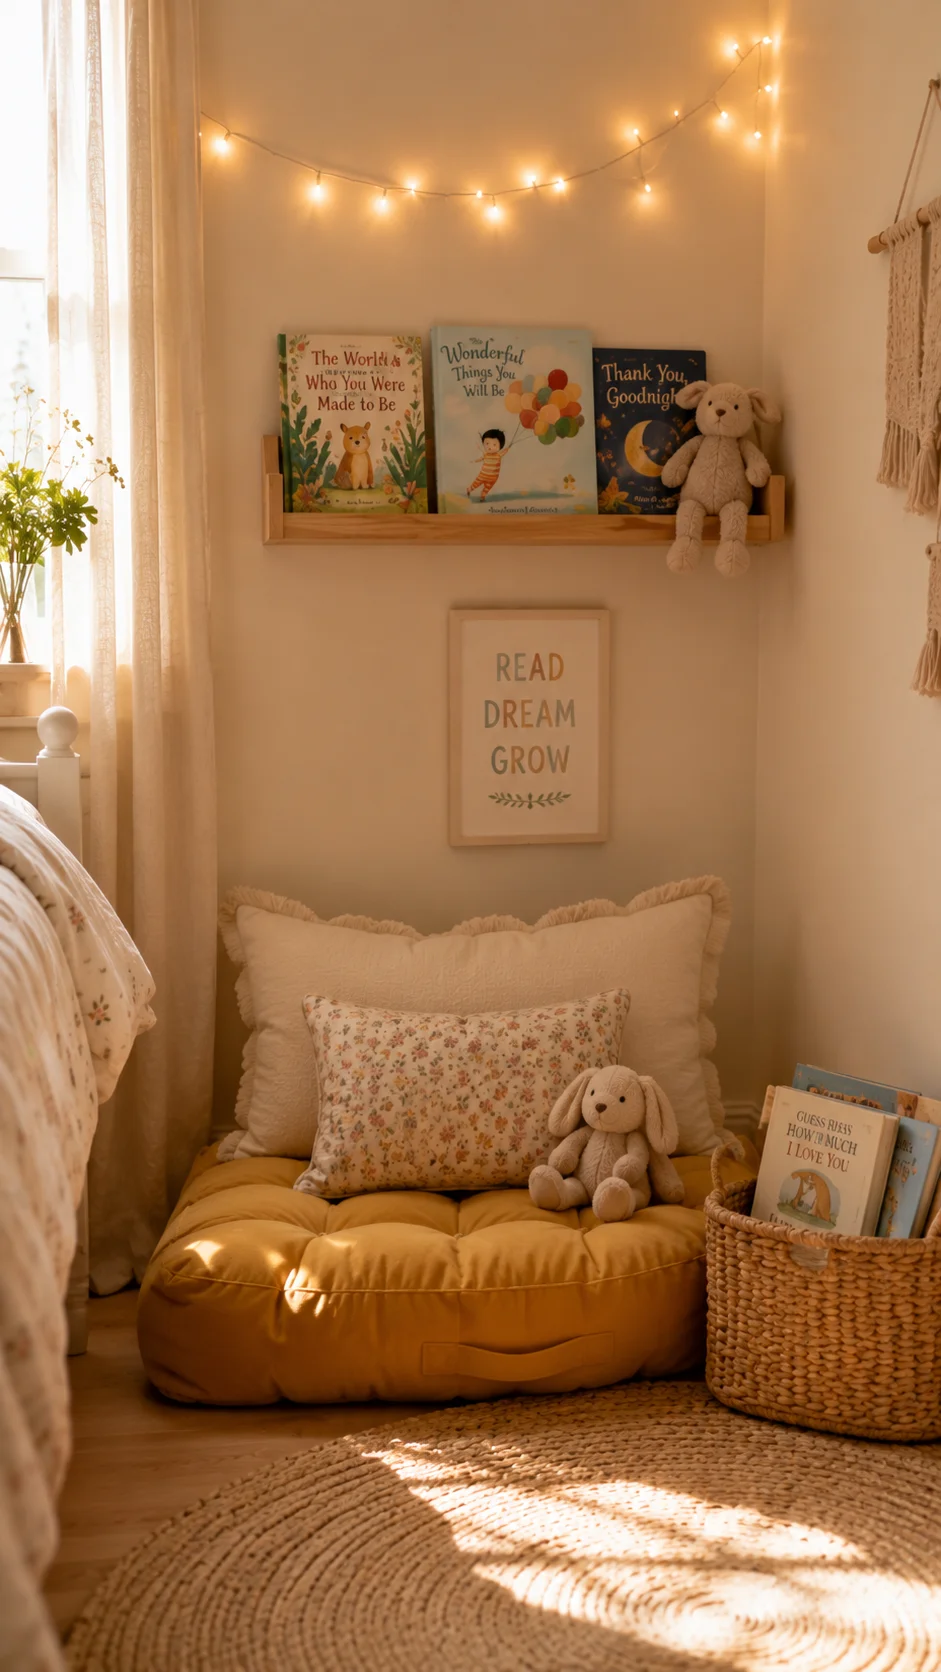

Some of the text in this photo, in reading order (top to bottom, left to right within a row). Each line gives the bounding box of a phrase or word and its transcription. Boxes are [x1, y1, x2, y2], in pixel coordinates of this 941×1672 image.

[311, 350, 339, 366] The
[440, 340, 526, 366] Wonderful
[305, 374, 405, 392] Who You Were
[451, 364, 516, 383] Things You
[601, 363, 688, 385] Thank You,
[463, 384, 505, 397] Will Be
[606, 387, 676, 411] Goodnigh
[317, 396, 396, 411] Made to Be
[496, 653, 564, 681] READ
[484, 699, 576, 728] DREAM
[491, 745, 570, 775] GROW
[786, 1123, 815, 1142] HOW
[824, 1133, 858, 1156] MUCH
[786, 1141, 850, 1173] I LOVE YOU
